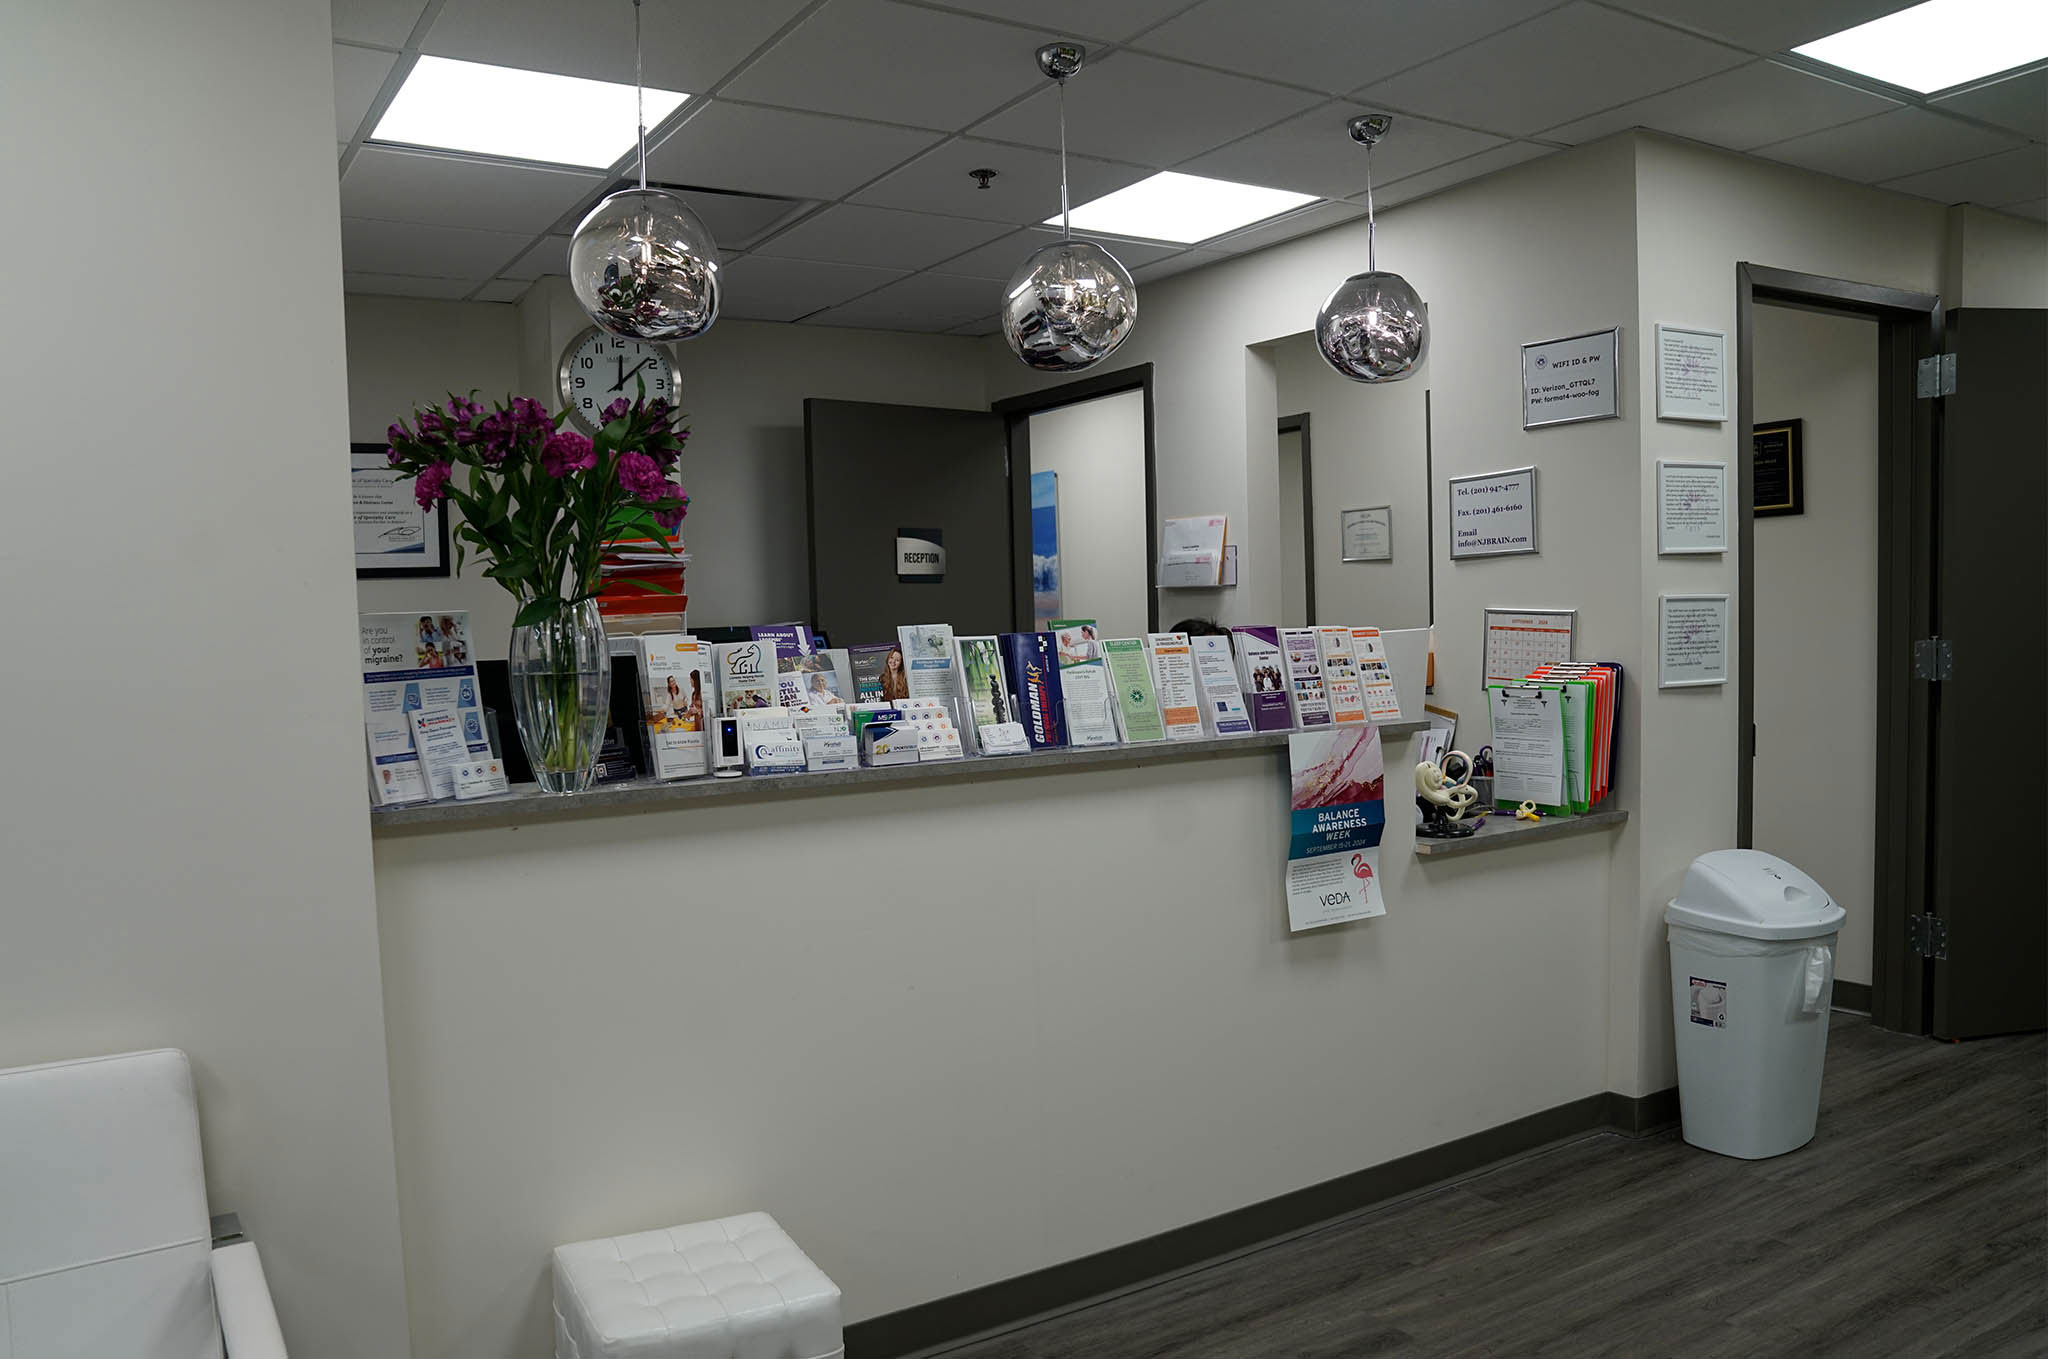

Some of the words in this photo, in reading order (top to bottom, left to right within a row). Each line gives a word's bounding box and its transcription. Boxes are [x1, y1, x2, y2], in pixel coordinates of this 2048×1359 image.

[580, 357, 594, 369] 10
[648, 358, 657, 370] 2
[1589, 355, 1600, 363] PW
[575, 377, 585, 388] 9
[656, 379, 664, 389] 3
[1545, 390, 1600, 403] format4-woo-fog
[583, 398, 593, 408] 8
[1471, 486, 1488, 495] (201)
[1489, 483, 1519, 493] 947-4777
[1473, 507, 1490, 515] (201)
[1492, 504, 1522, 514] 461-6160
[1458, 529, 1477, 537] Email
[1458, 536, 1527, 547] info@NJBRAIN.com
[904, 552, 940, 563] RECEPTION
[372, 647, 390, 657] your
[365, 654, 403, 665] migraine?
[1028, 682, 1045, 743] GOLDMAN
[772, 745, 800, 753] affinity
[1318, 808, 1360, 822] BALANCE
[1312, 818, 1367, 834] AWARENESS
[1326, 829, 1351, 841] WEEK
[1306, 843, 1338, 854] SEPTEMBER
